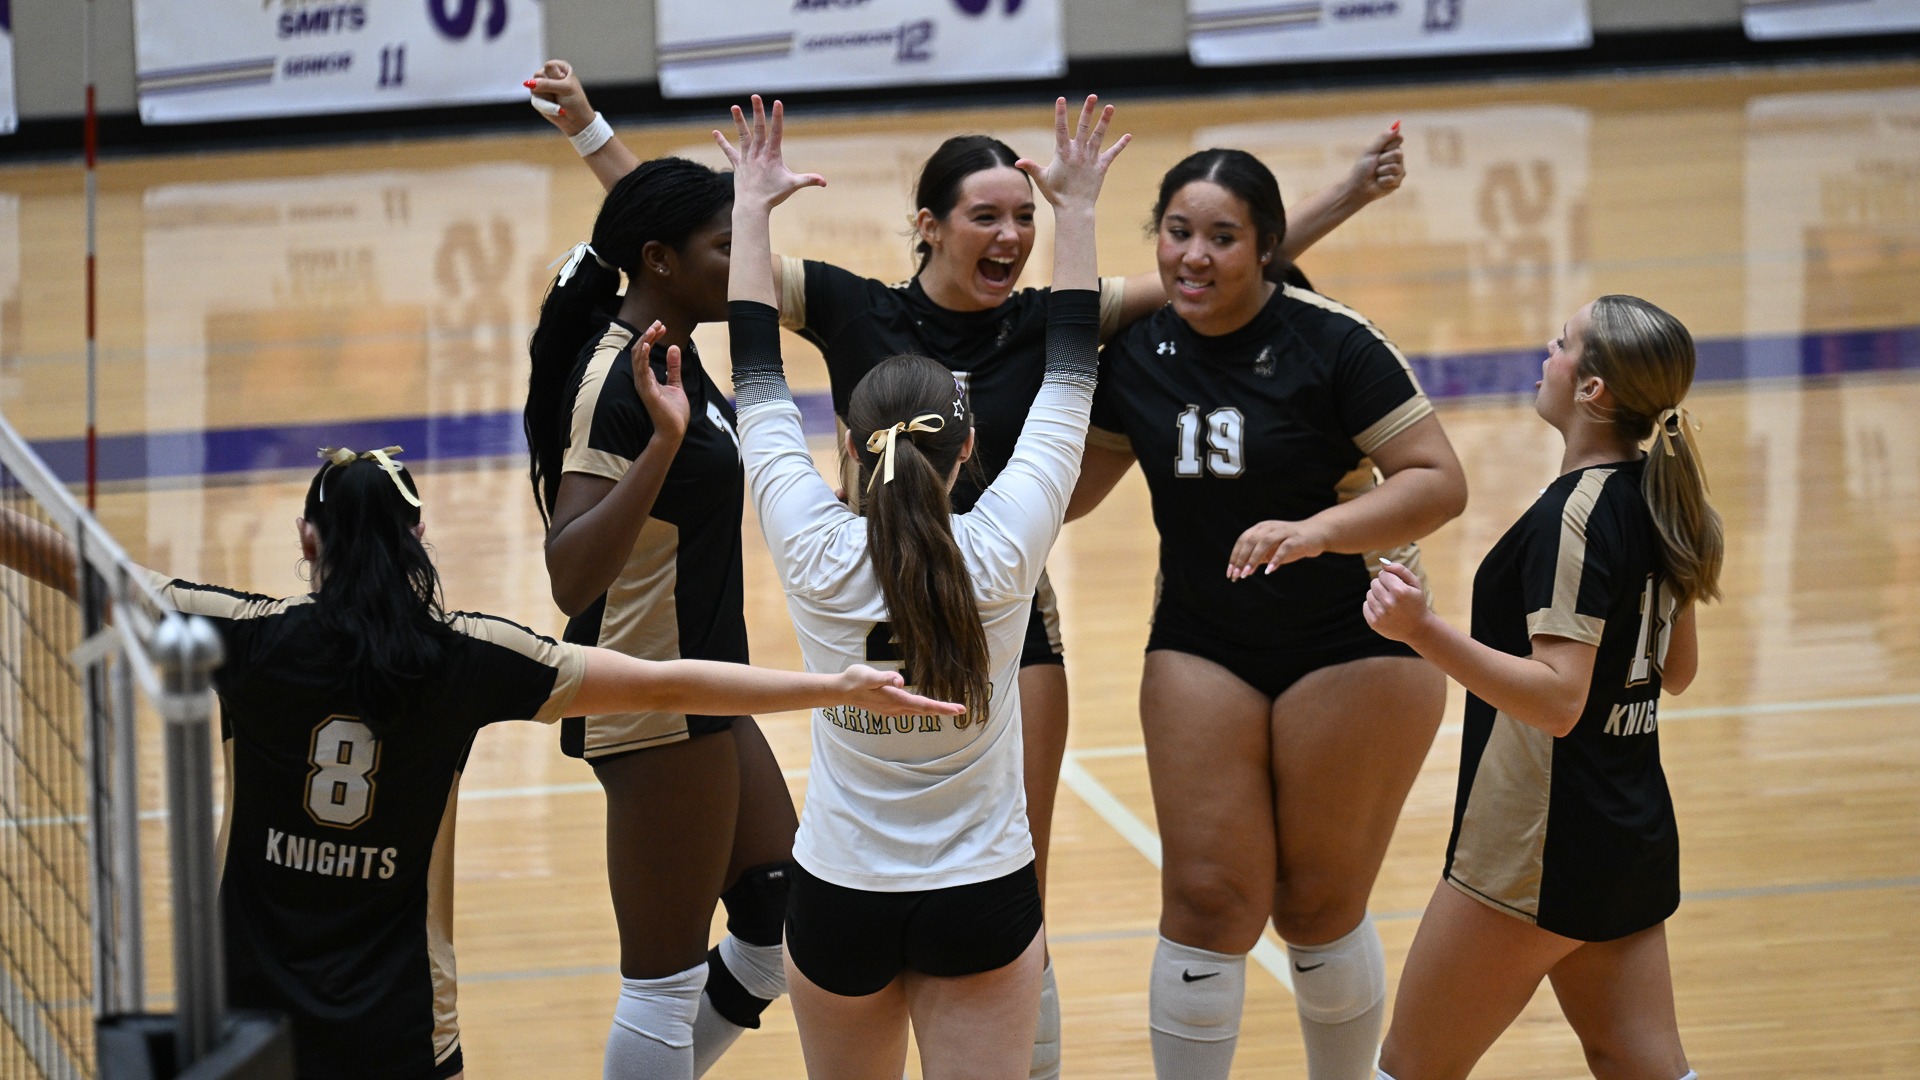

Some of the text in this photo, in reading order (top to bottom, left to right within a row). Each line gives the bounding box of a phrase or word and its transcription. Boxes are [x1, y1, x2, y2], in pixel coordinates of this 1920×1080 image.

[278, 6, 367, 39] SMITS
[378, 44, 406, 89] 11
[1174, 403, 1246, 479] 19
[303, 714, 382, 830] 8
[265, 827, 398, 880] KNIGHTS
